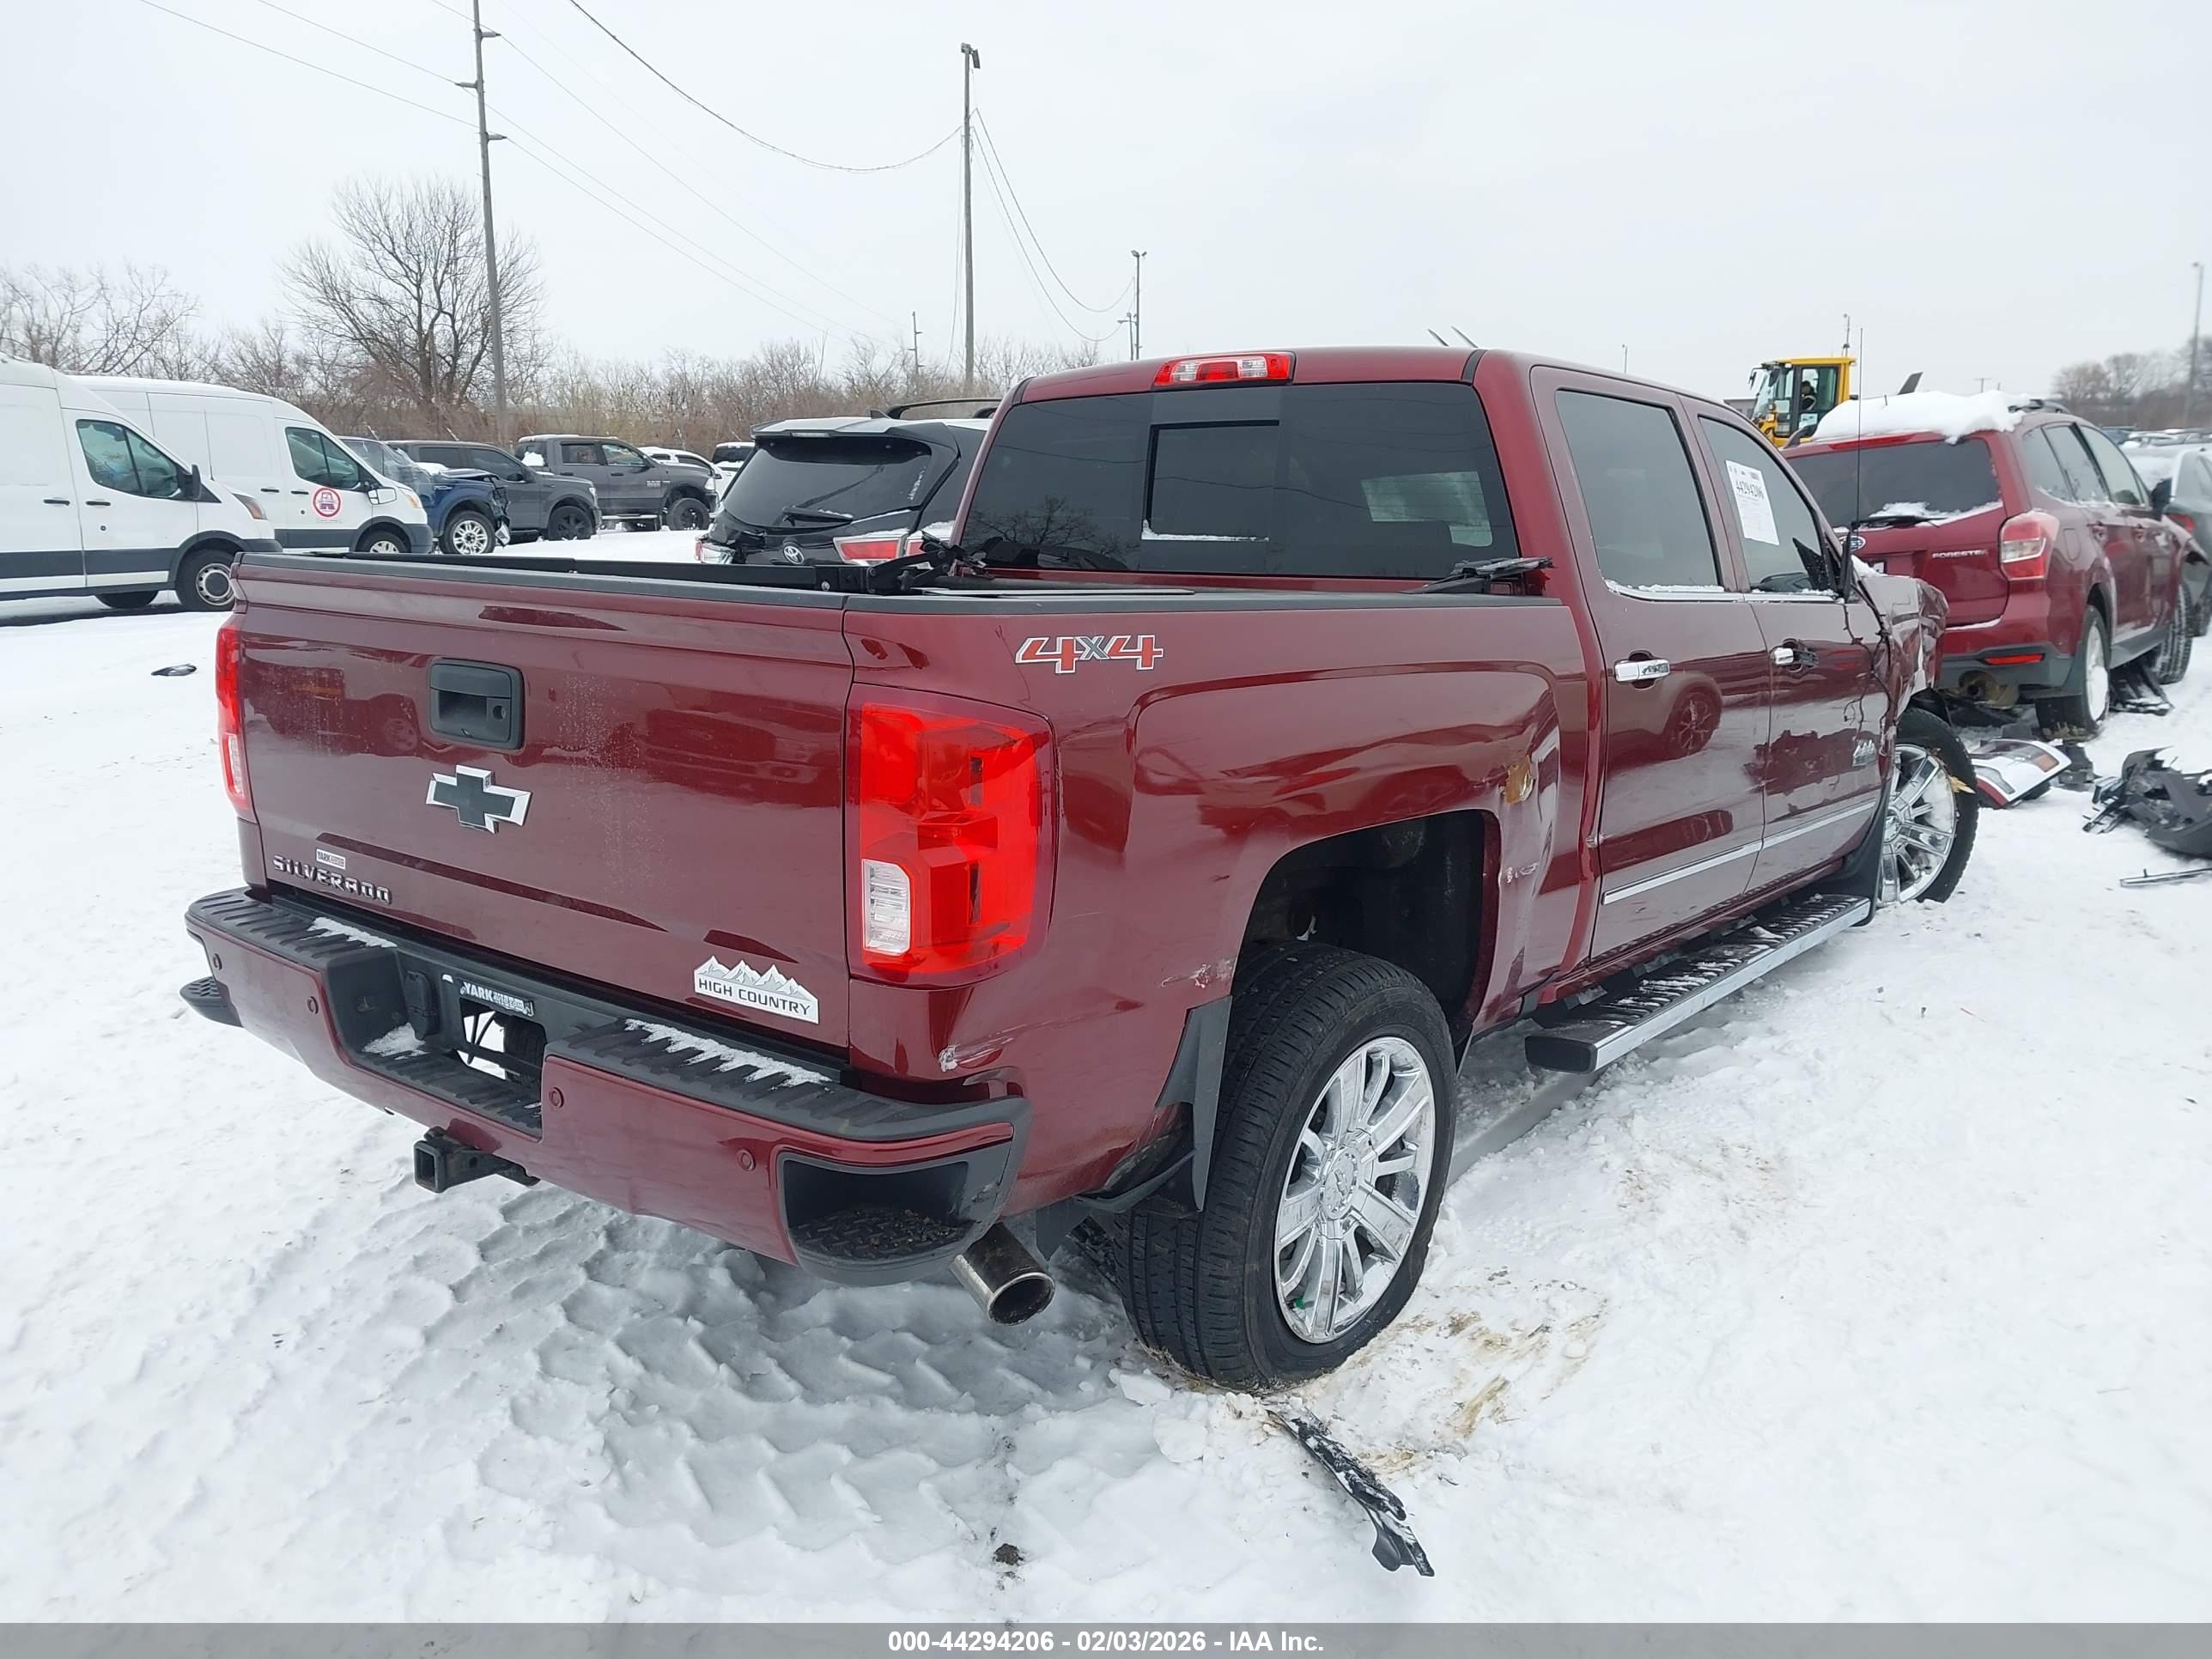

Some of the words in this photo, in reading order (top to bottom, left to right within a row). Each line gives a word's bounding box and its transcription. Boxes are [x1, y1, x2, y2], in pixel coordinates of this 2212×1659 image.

[273, 854, 392, 904] SILVERADO
[464, 981, 494, 1002] YARK
[699, 978, 732, 997] HIGH
[738, 988, 811, 1015] COUNTRY
